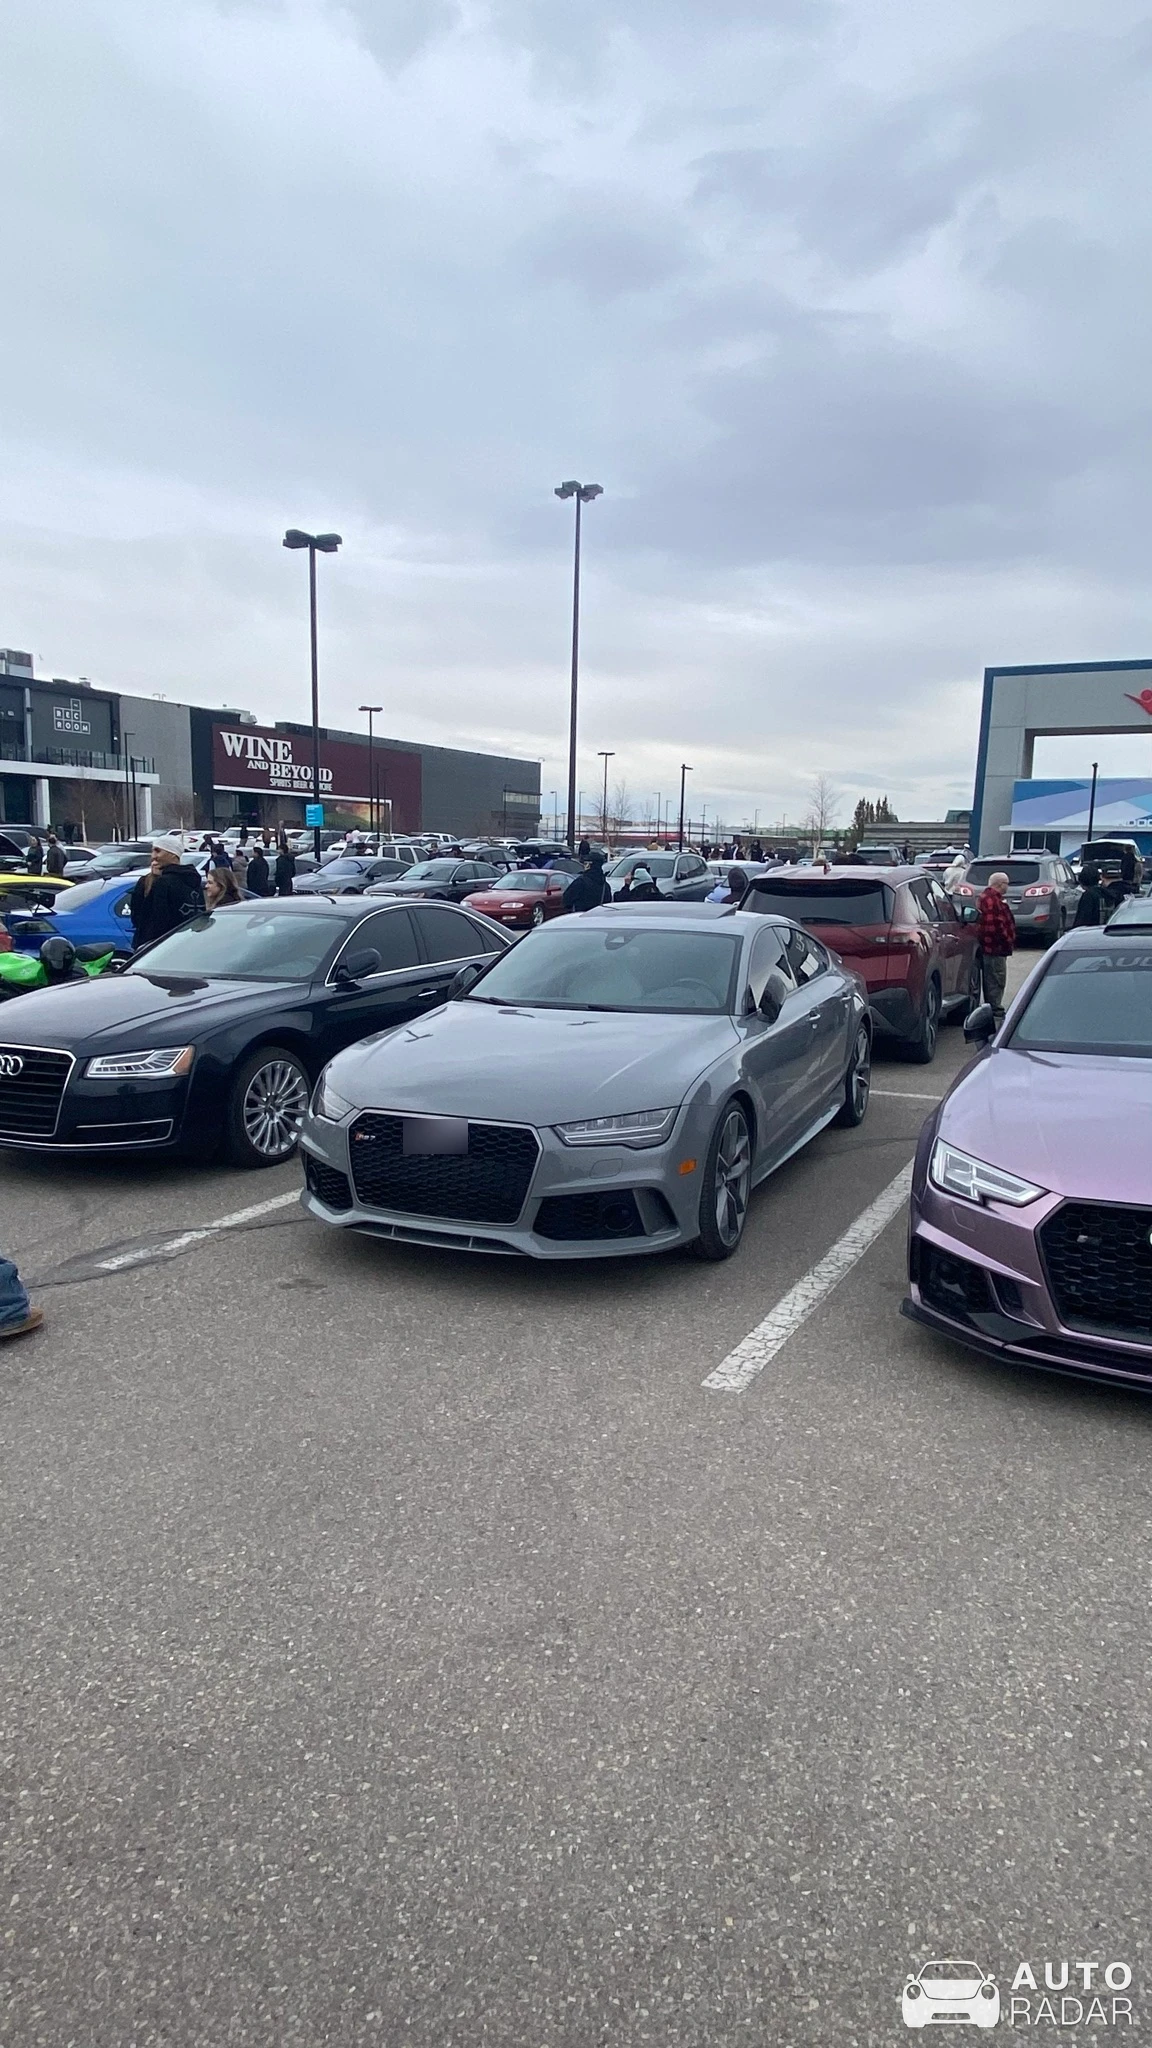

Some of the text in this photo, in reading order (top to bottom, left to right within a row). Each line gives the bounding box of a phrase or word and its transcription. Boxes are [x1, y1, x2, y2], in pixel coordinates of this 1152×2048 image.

[56, 710, 79, 720] REC
[56, 721, 88, 731] ROOM
[219, 731, 293, 764] WINE
[247, 760, 269, 770] AND
[269, 778, 292, 788] SPIRITS
